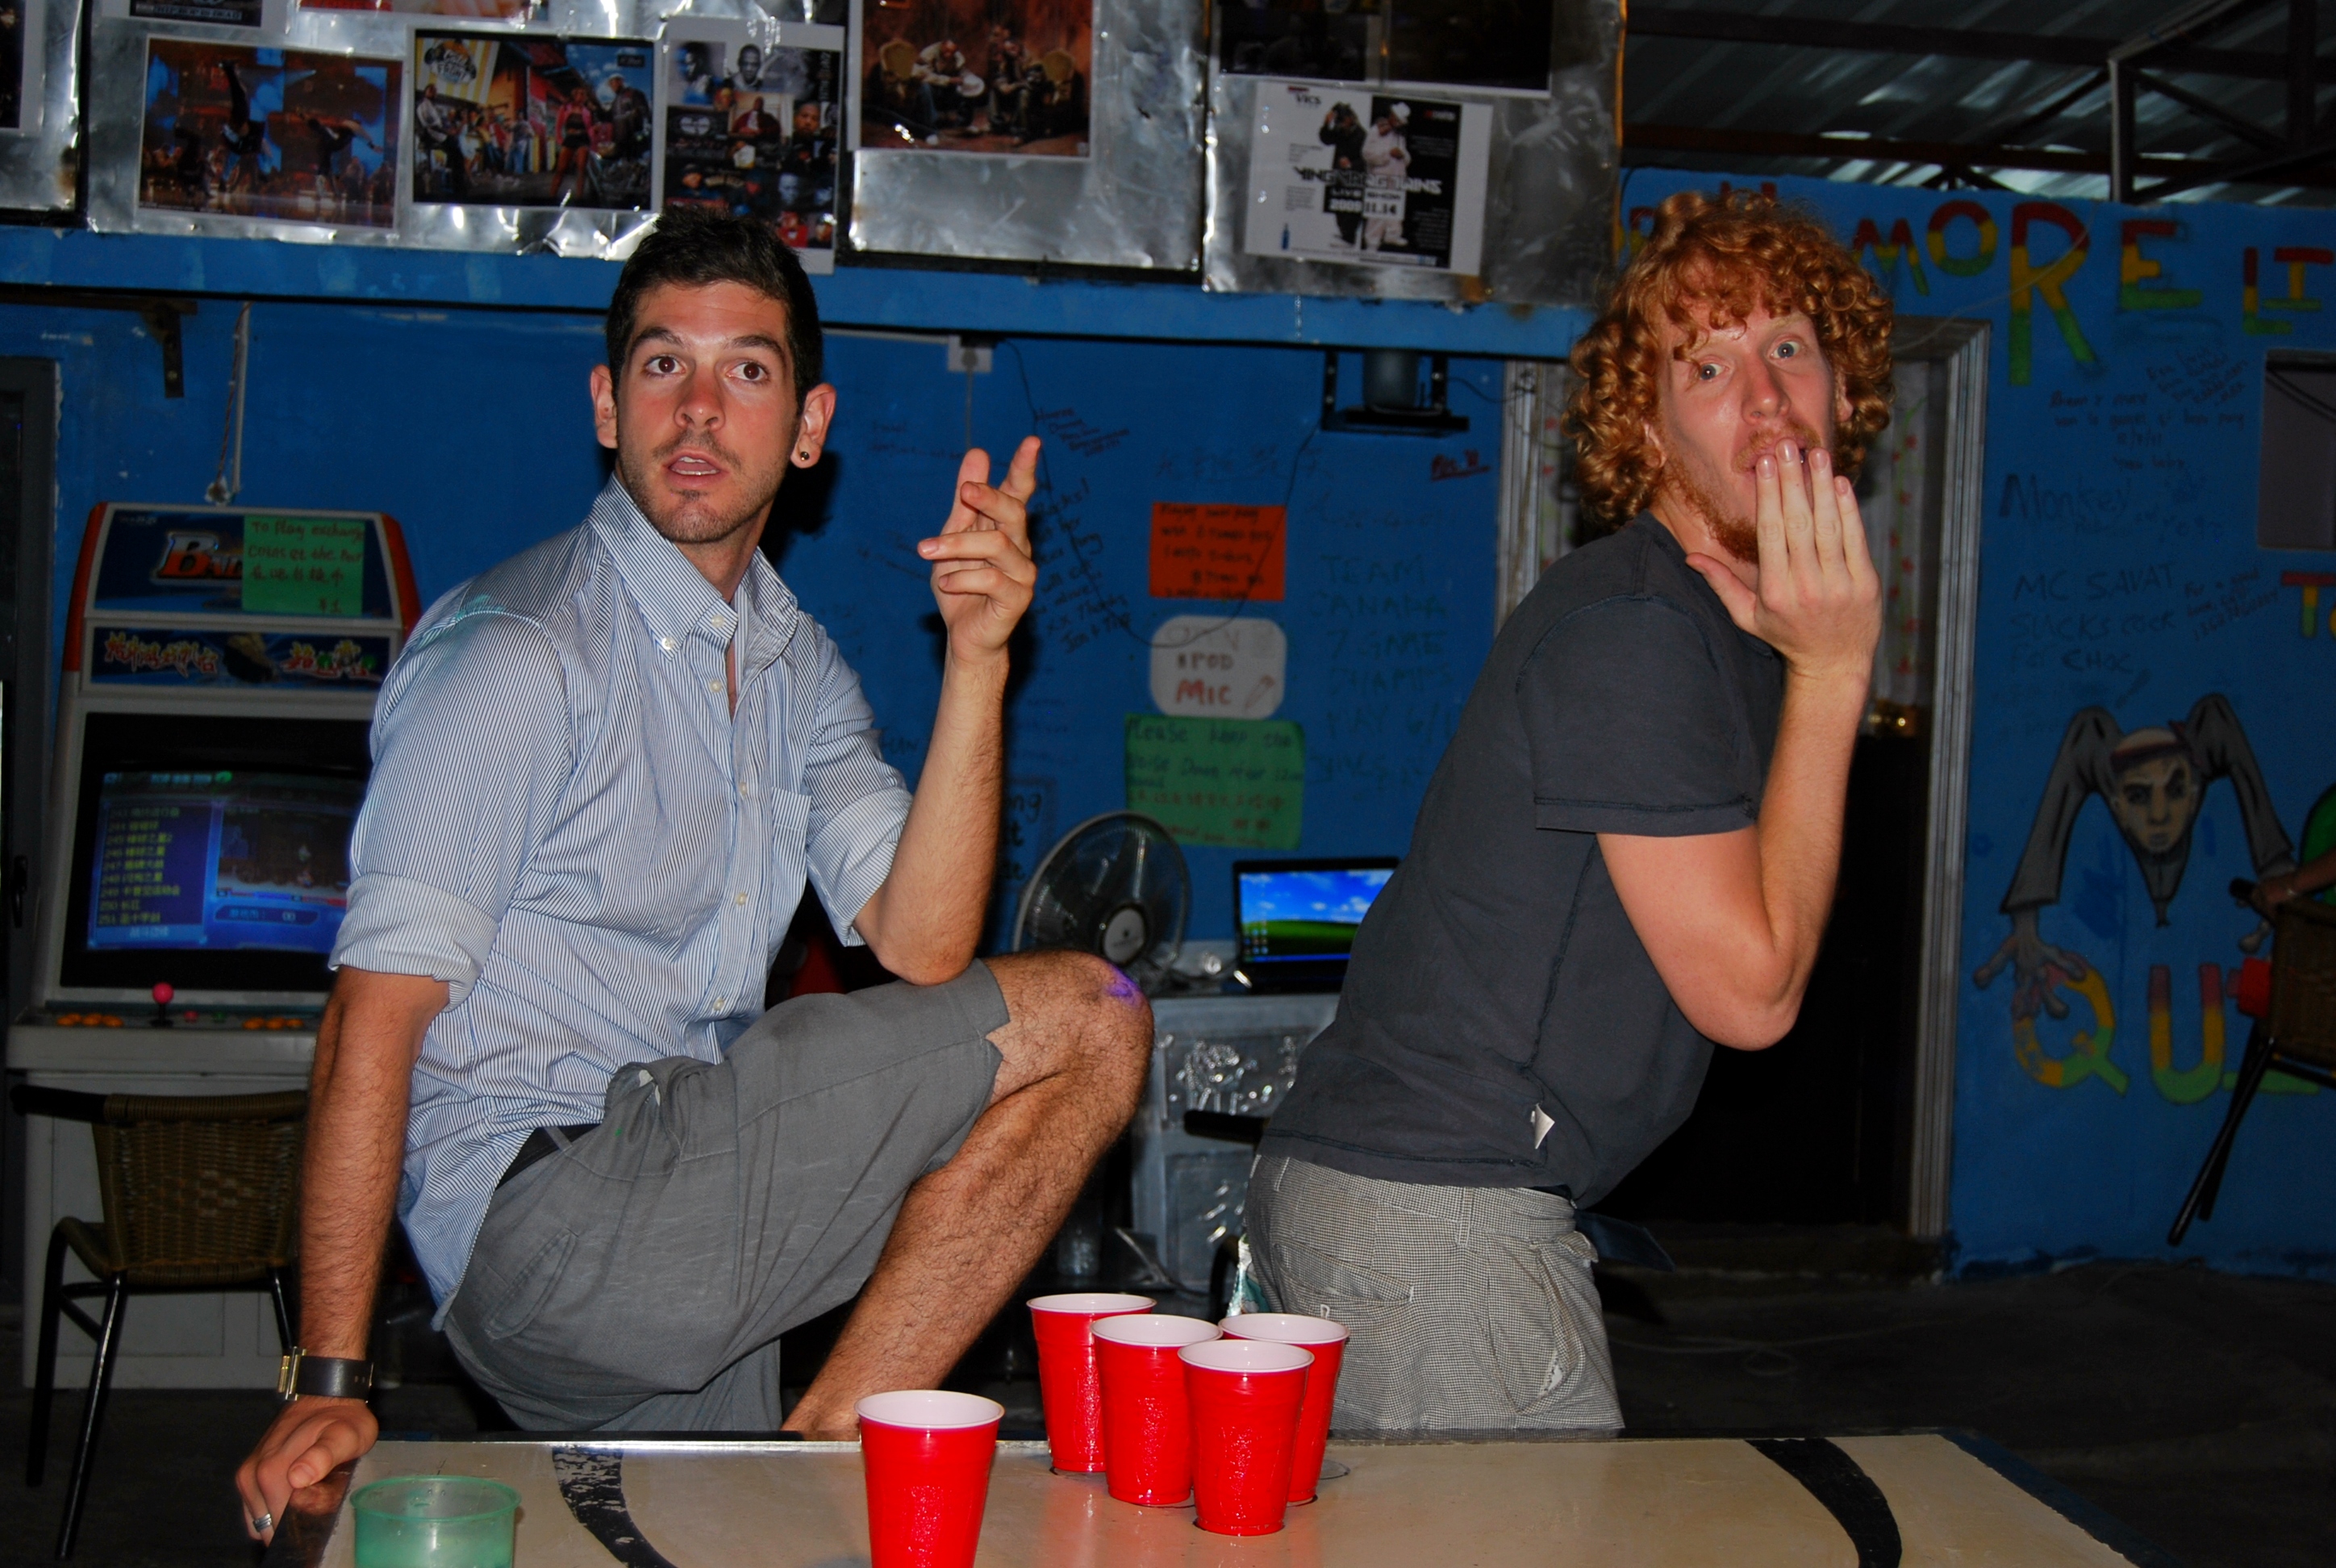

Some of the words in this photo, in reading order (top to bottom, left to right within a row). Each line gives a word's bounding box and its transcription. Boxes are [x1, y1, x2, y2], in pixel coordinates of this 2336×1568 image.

[1853, 201, 2202, 386] MORE
[2013, 569, 2068, 601] MC
[1175, 678, 1231, 706] MIC
